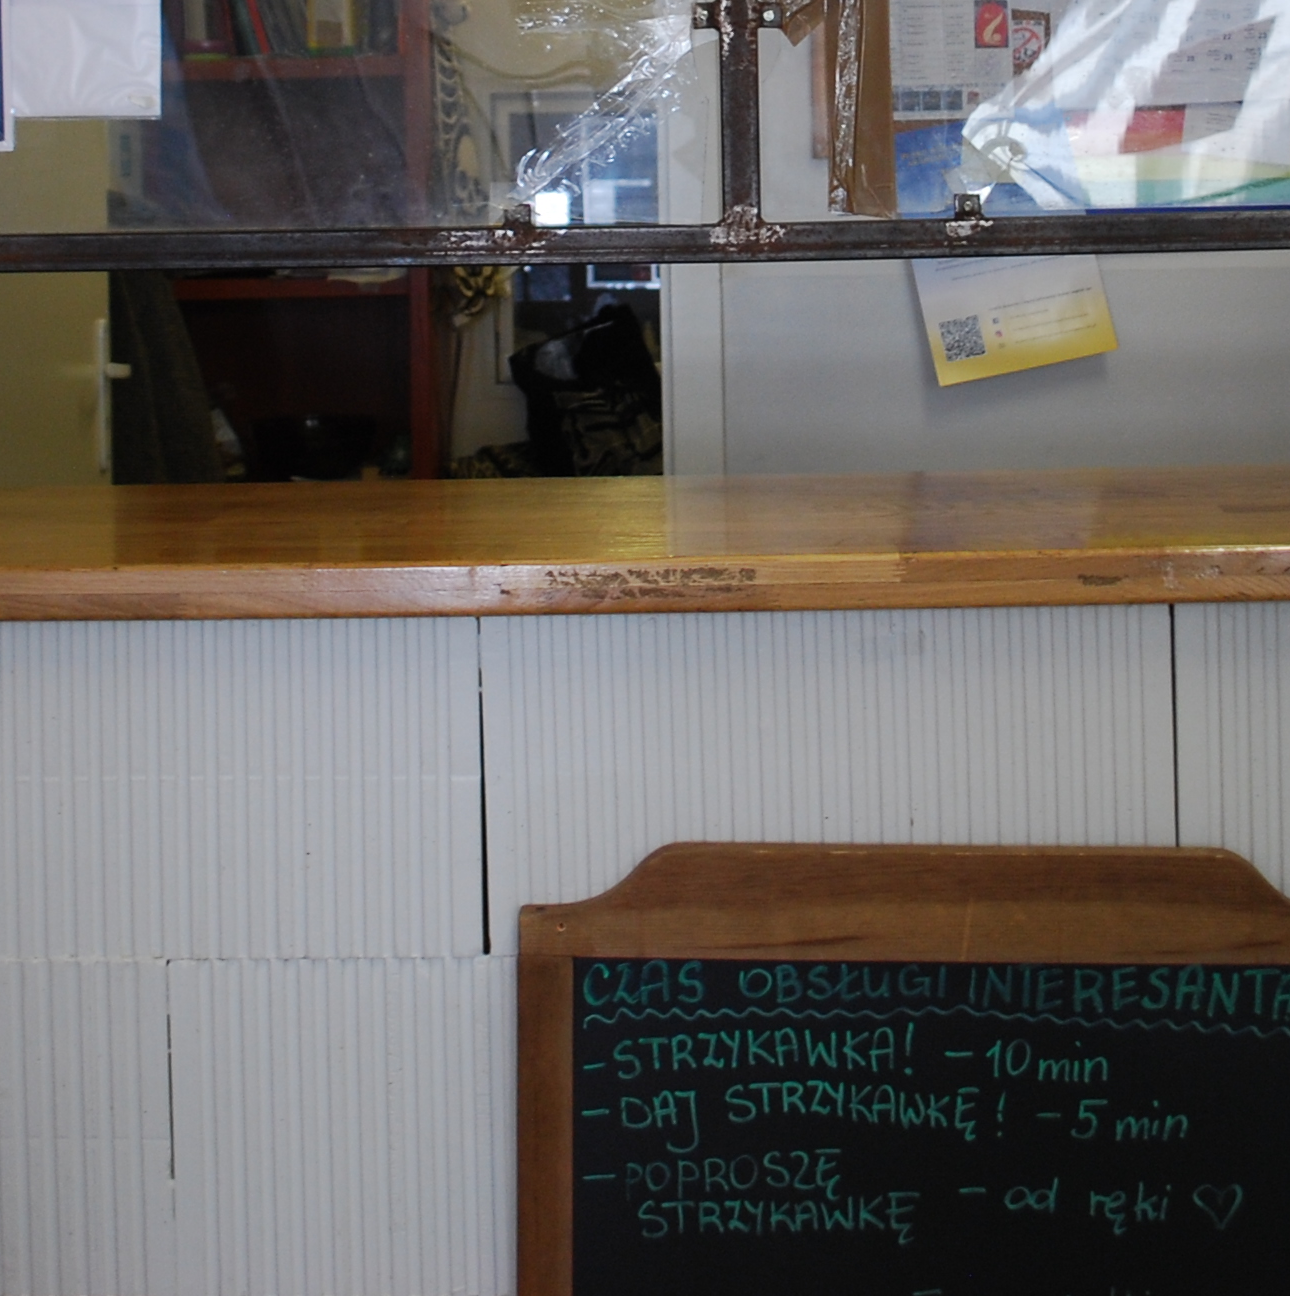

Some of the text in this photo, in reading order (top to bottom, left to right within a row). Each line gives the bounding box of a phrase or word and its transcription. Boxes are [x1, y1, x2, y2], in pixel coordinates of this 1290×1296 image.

[582, 958, 705, 1006] CZAS
[738, 962, 946, 1004] OBSŁUGI
[612, 1021, 915, 1080] STRZYKAWKA!
[985, 1037, 1032, 1078] 10
[1037, 1040, 1109, 1083] min
[620, 1089, 699, 1153] DAJ
[1070, 1098, 1109, 1139] 5
[1114, 1100, 1190, 1142] min
[625, 1147, 842, 1201] POPROSZĘ
[637, 1190, 921, 1246] STRZYKAWKĘ
[1003, 1176, 1059, 1215] od
[1088, 1180, 1172, 1237] ręki
